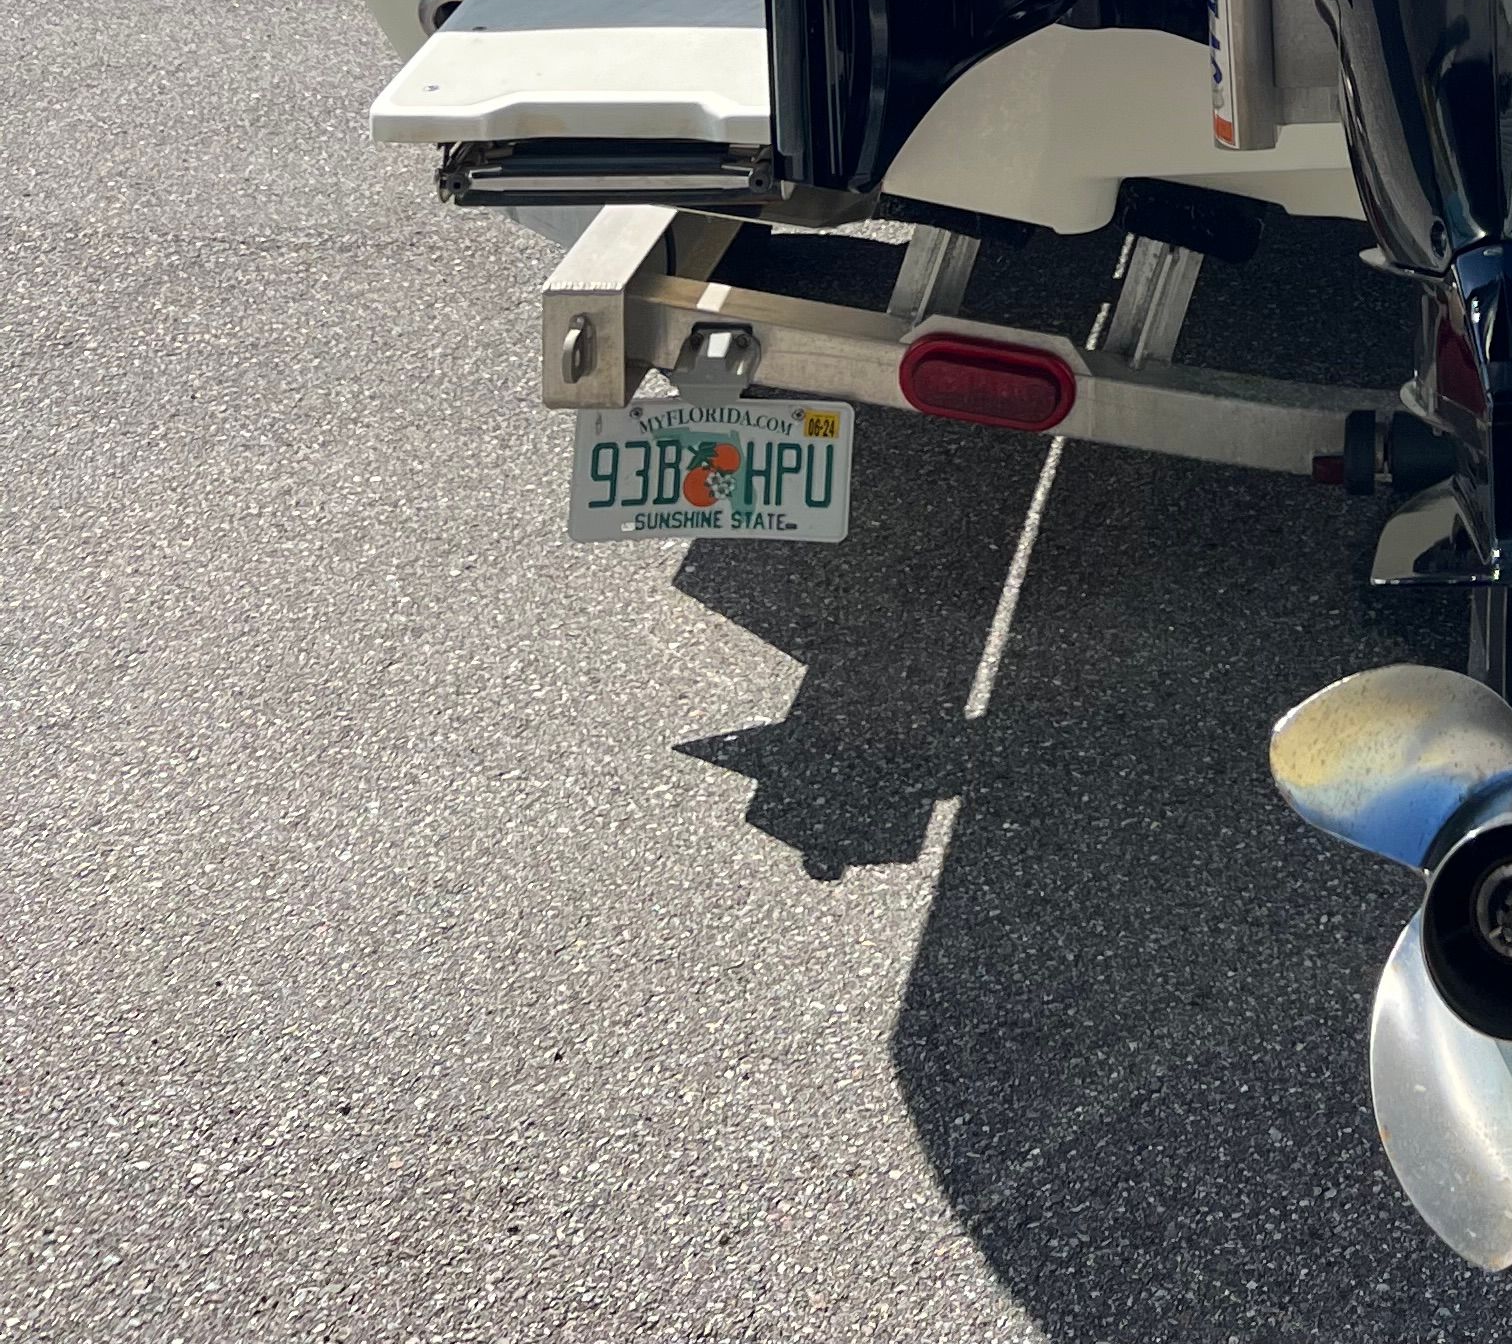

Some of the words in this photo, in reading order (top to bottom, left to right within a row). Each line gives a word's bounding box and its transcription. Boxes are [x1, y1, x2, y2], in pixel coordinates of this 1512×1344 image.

[639, 407, 793, 436] MYFLORIDA.COM
[588, 439, 682, 508] 93B
[744, 440, 834, 508] HPU
[634, 511, 723, 530] SUNSHINE
[731, 511, 786, 531] STATE
